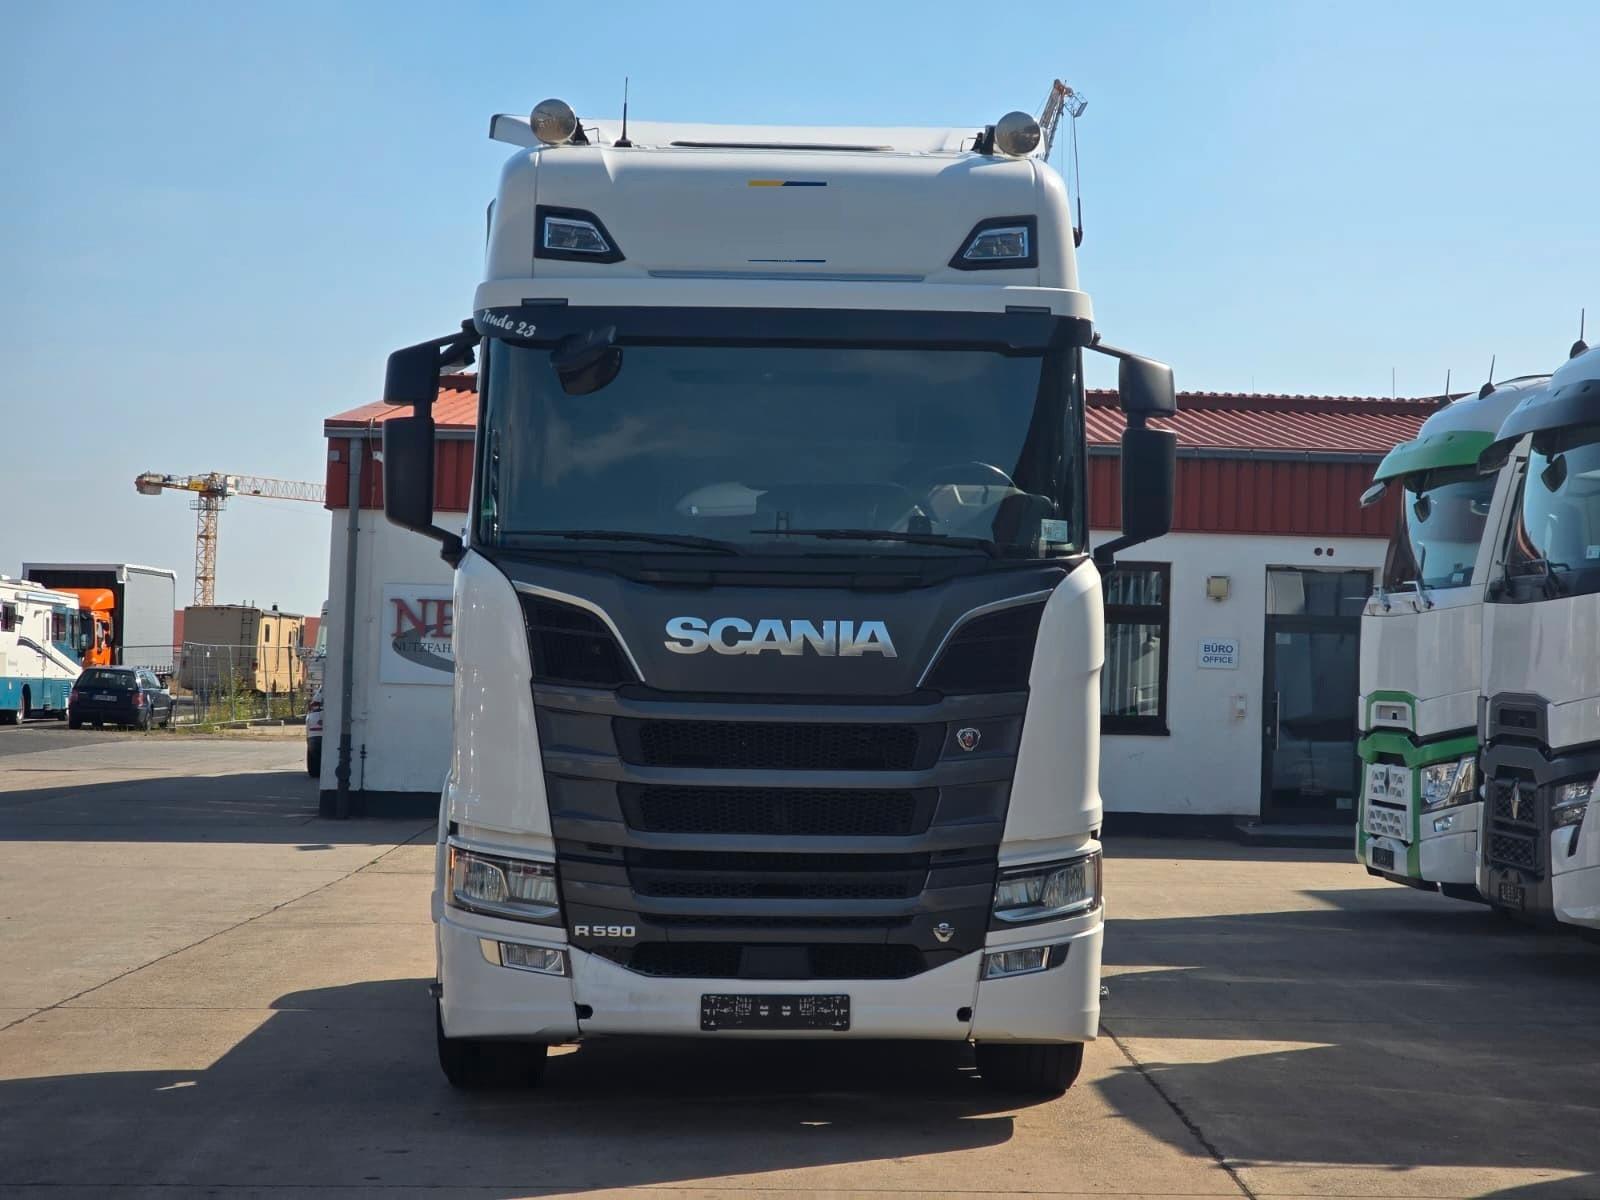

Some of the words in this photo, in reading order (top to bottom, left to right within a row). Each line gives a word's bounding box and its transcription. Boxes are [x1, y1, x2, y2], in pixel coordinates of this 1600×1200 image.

[515, 321, 537, 338] 23
[663, 616, 898, 658] SCANIA
[1203, 642, 1234, 653] BÜRO
[1202, 655, 1233, 664] OFFICE
